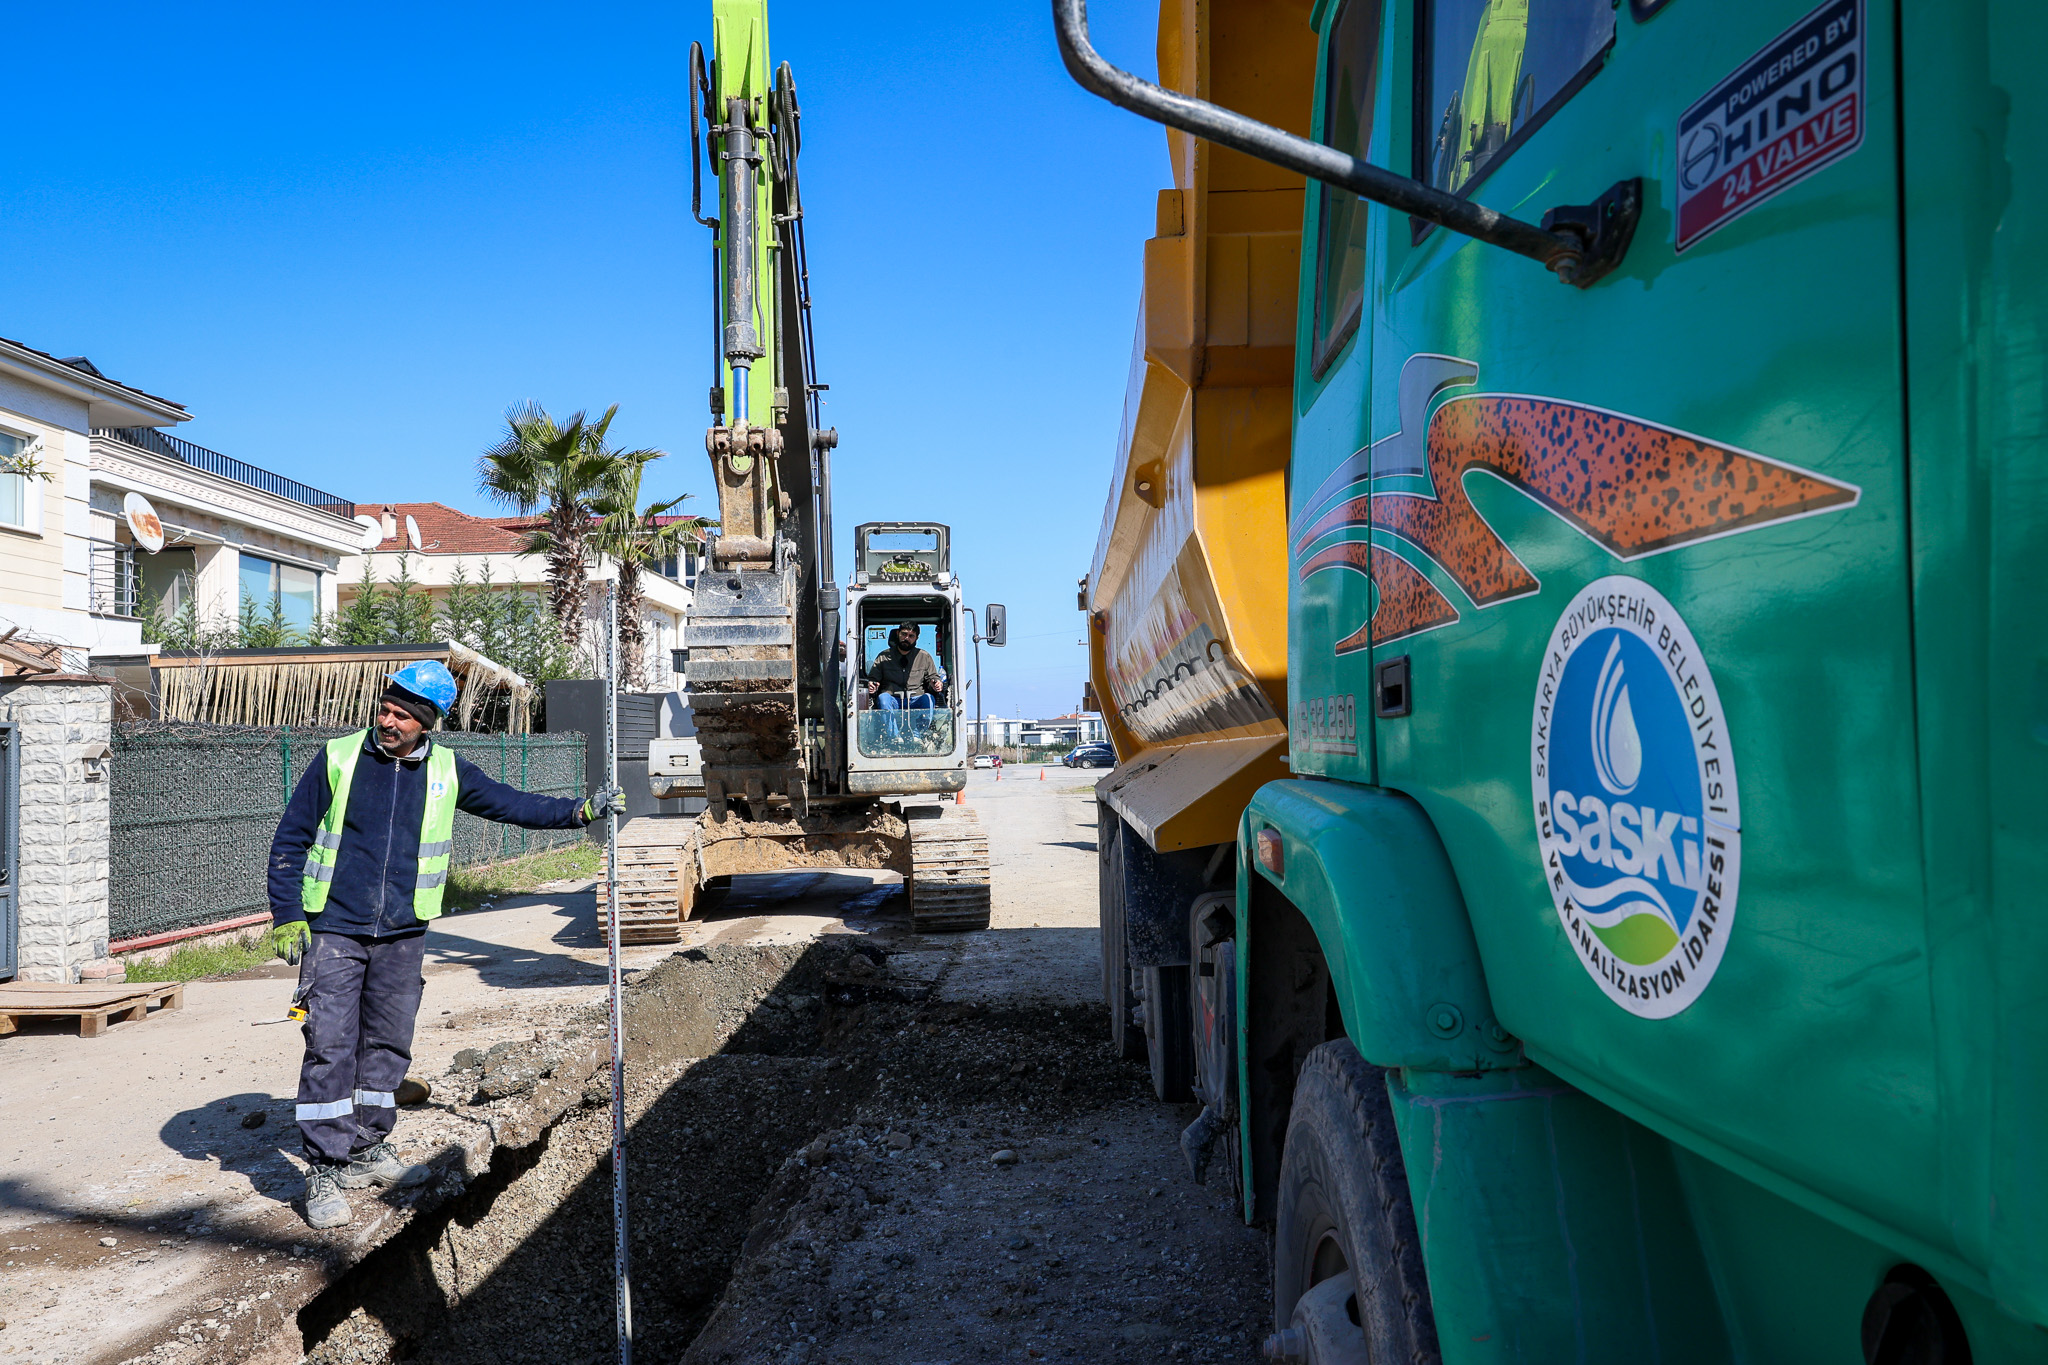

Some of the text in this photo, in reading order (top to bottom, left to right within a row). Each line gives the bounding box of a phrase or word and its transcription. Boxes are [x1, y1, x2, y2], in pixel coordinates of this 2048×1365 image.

[1723, 51, 1857, 166] HINO
[1728, 10, 1853, 114] POWERED BY
[1722, 100, 1853, 209] 24 VALVE
[1537, 594, 1728, 814] SAKARYA BÜYÜKŞEHİR BELEDİYESİ
[1539, 800, 1726, 1000] SU VE KANALİZASYON İDARESİ
